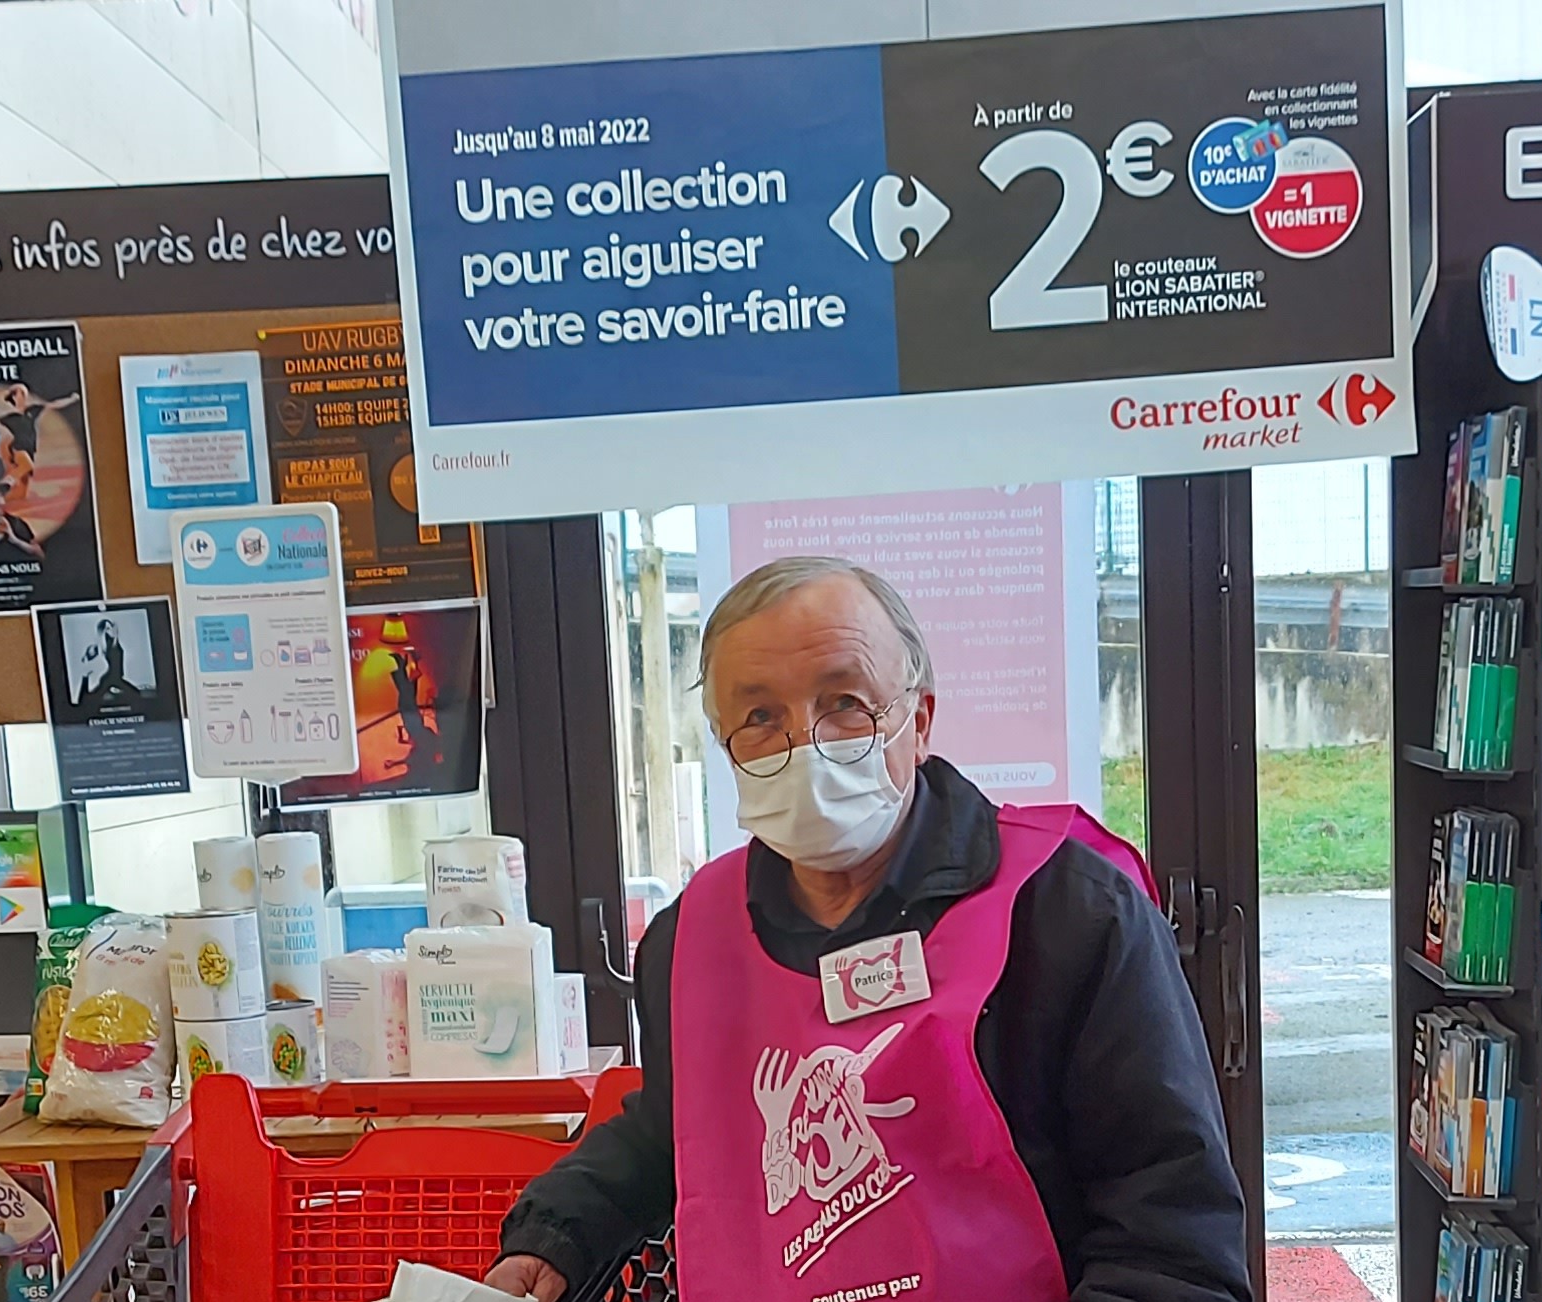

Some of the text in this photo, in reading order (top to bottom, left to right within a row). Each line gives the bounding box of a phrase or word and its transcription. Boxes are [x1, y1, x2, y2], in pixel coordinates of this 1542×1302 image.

[1247, 81, 1358, 103] Avec la carte fidélité
[974, 101, 1073, 129] À partir de
[1265, 98, 1358, 116] en collectionnant
[1289, 113, 1358, 131] les vignettes
[453, 117, 650, 157] Jusqu'au 8 mai 2022
[1200, 165, 1267, 186] D'ACHAT
[456, 161, 787, 223] Une collection
[1265, 205, 1348, 230] VIGNETTE
[13, 220, 102, 269] infos
[115, 225, 194, 279] près
[207, 218, 246, 261] de
[261, 216, 345, 258] chez
[356, 226, 394, 257] vo
[462, 228, 764, 298] pour aiguiser
[1115, 257, 1217, 277] le couteaux
[1115, 278, 1160, 298] LION
[1116, 292, 1267, 319] INTERNATIONAL
[465, 285, 846, 350] votre savoir-faire
[302, 330, 342, 351] UAV
[284, 355, 383, 375] DIMANCHE 6
[326, 378, 380, 392] MUNICIPAL
[357, 398, 399, 412] EQUIPE
[1111, 388, 1301, 430] Carrefour
[358, 411, 401, 426] EQUIPE
[1202, 422, 1304, 452] market
[432, 449, 511, 472] Carrefour.fr
[419, 983, 476, 996] SERVIETTE
[854, 970, 894, 988] Patrice
[431, 1008, 476, 1023] maxi
[889, 1274, 921, 1298] par
